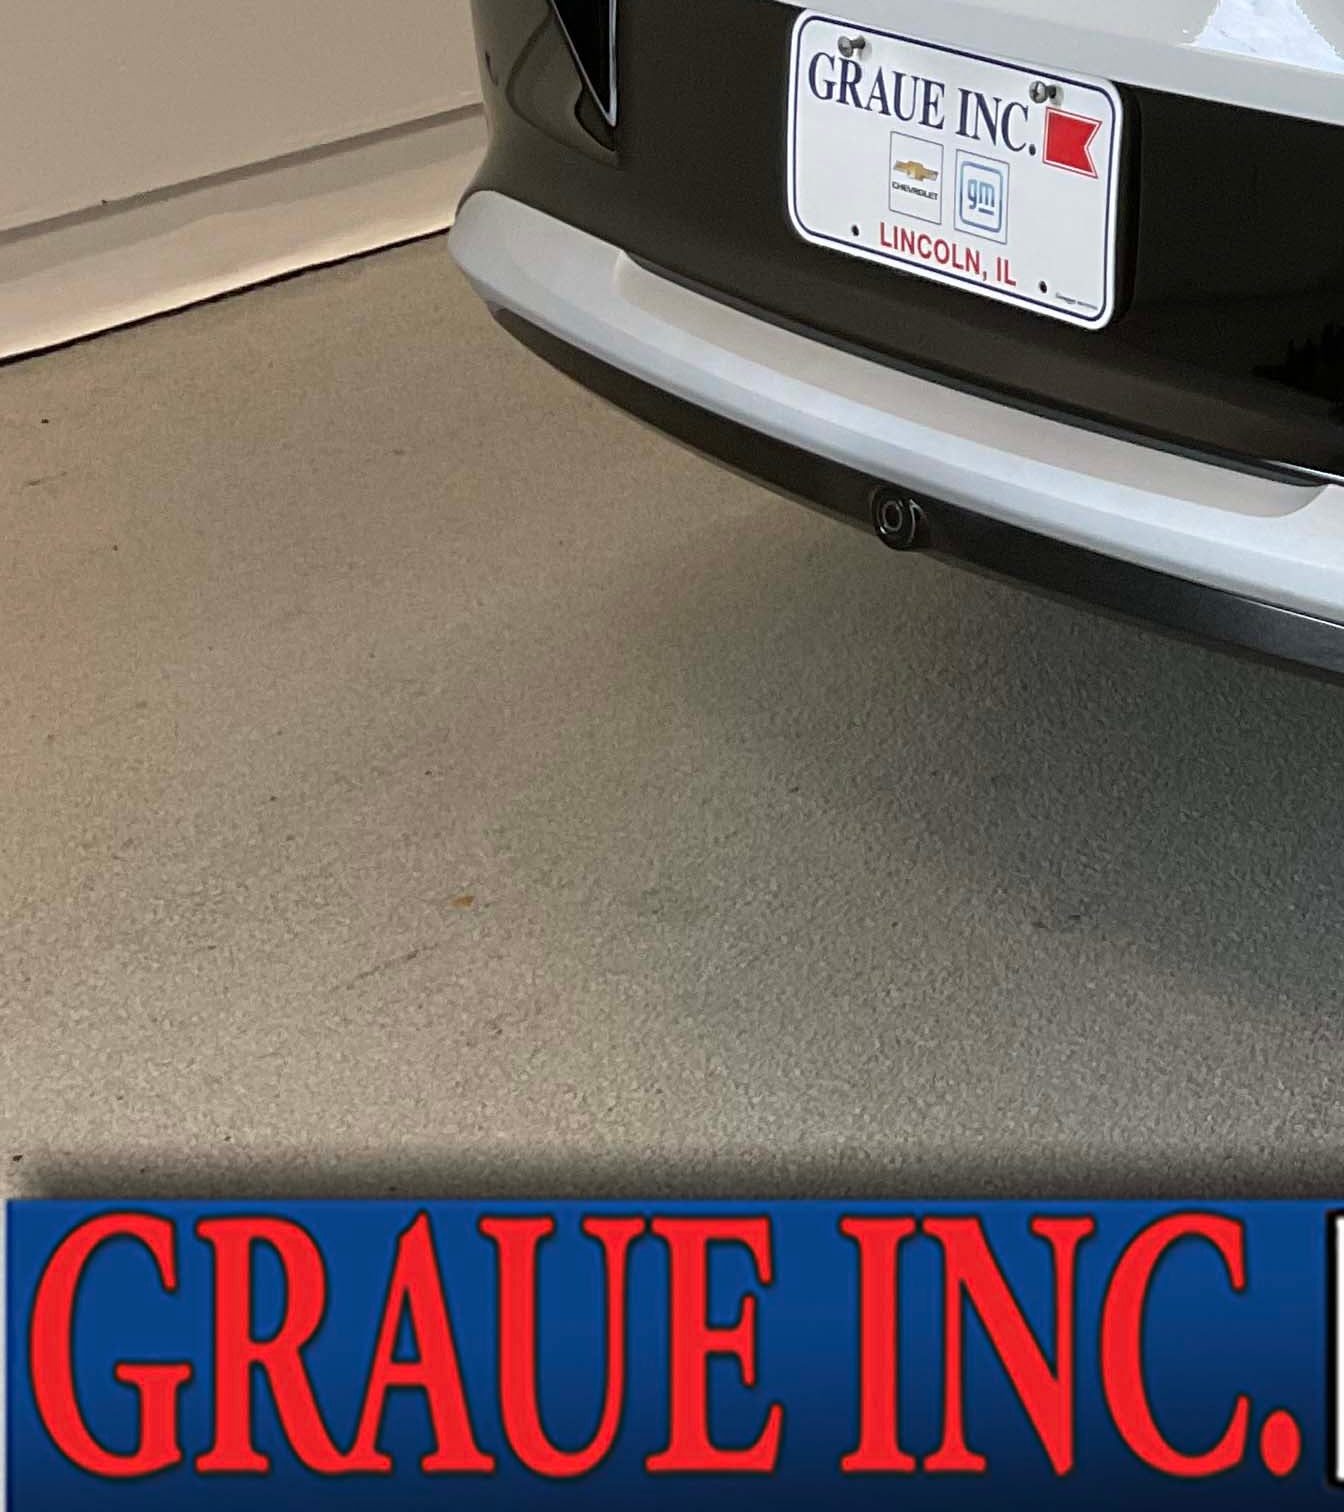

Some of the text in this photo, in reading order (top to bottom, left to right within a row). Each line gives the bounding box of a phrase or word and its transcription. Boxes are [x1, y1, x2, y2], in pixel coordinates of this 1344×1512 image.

[808, 51, 1037, 157] GRAUE INC.
[891, 180, 939, 201] CHEVROLET
[967, 178, 996, 210] gm
[879, 221, 1017, 287] LINCOLN, IL
